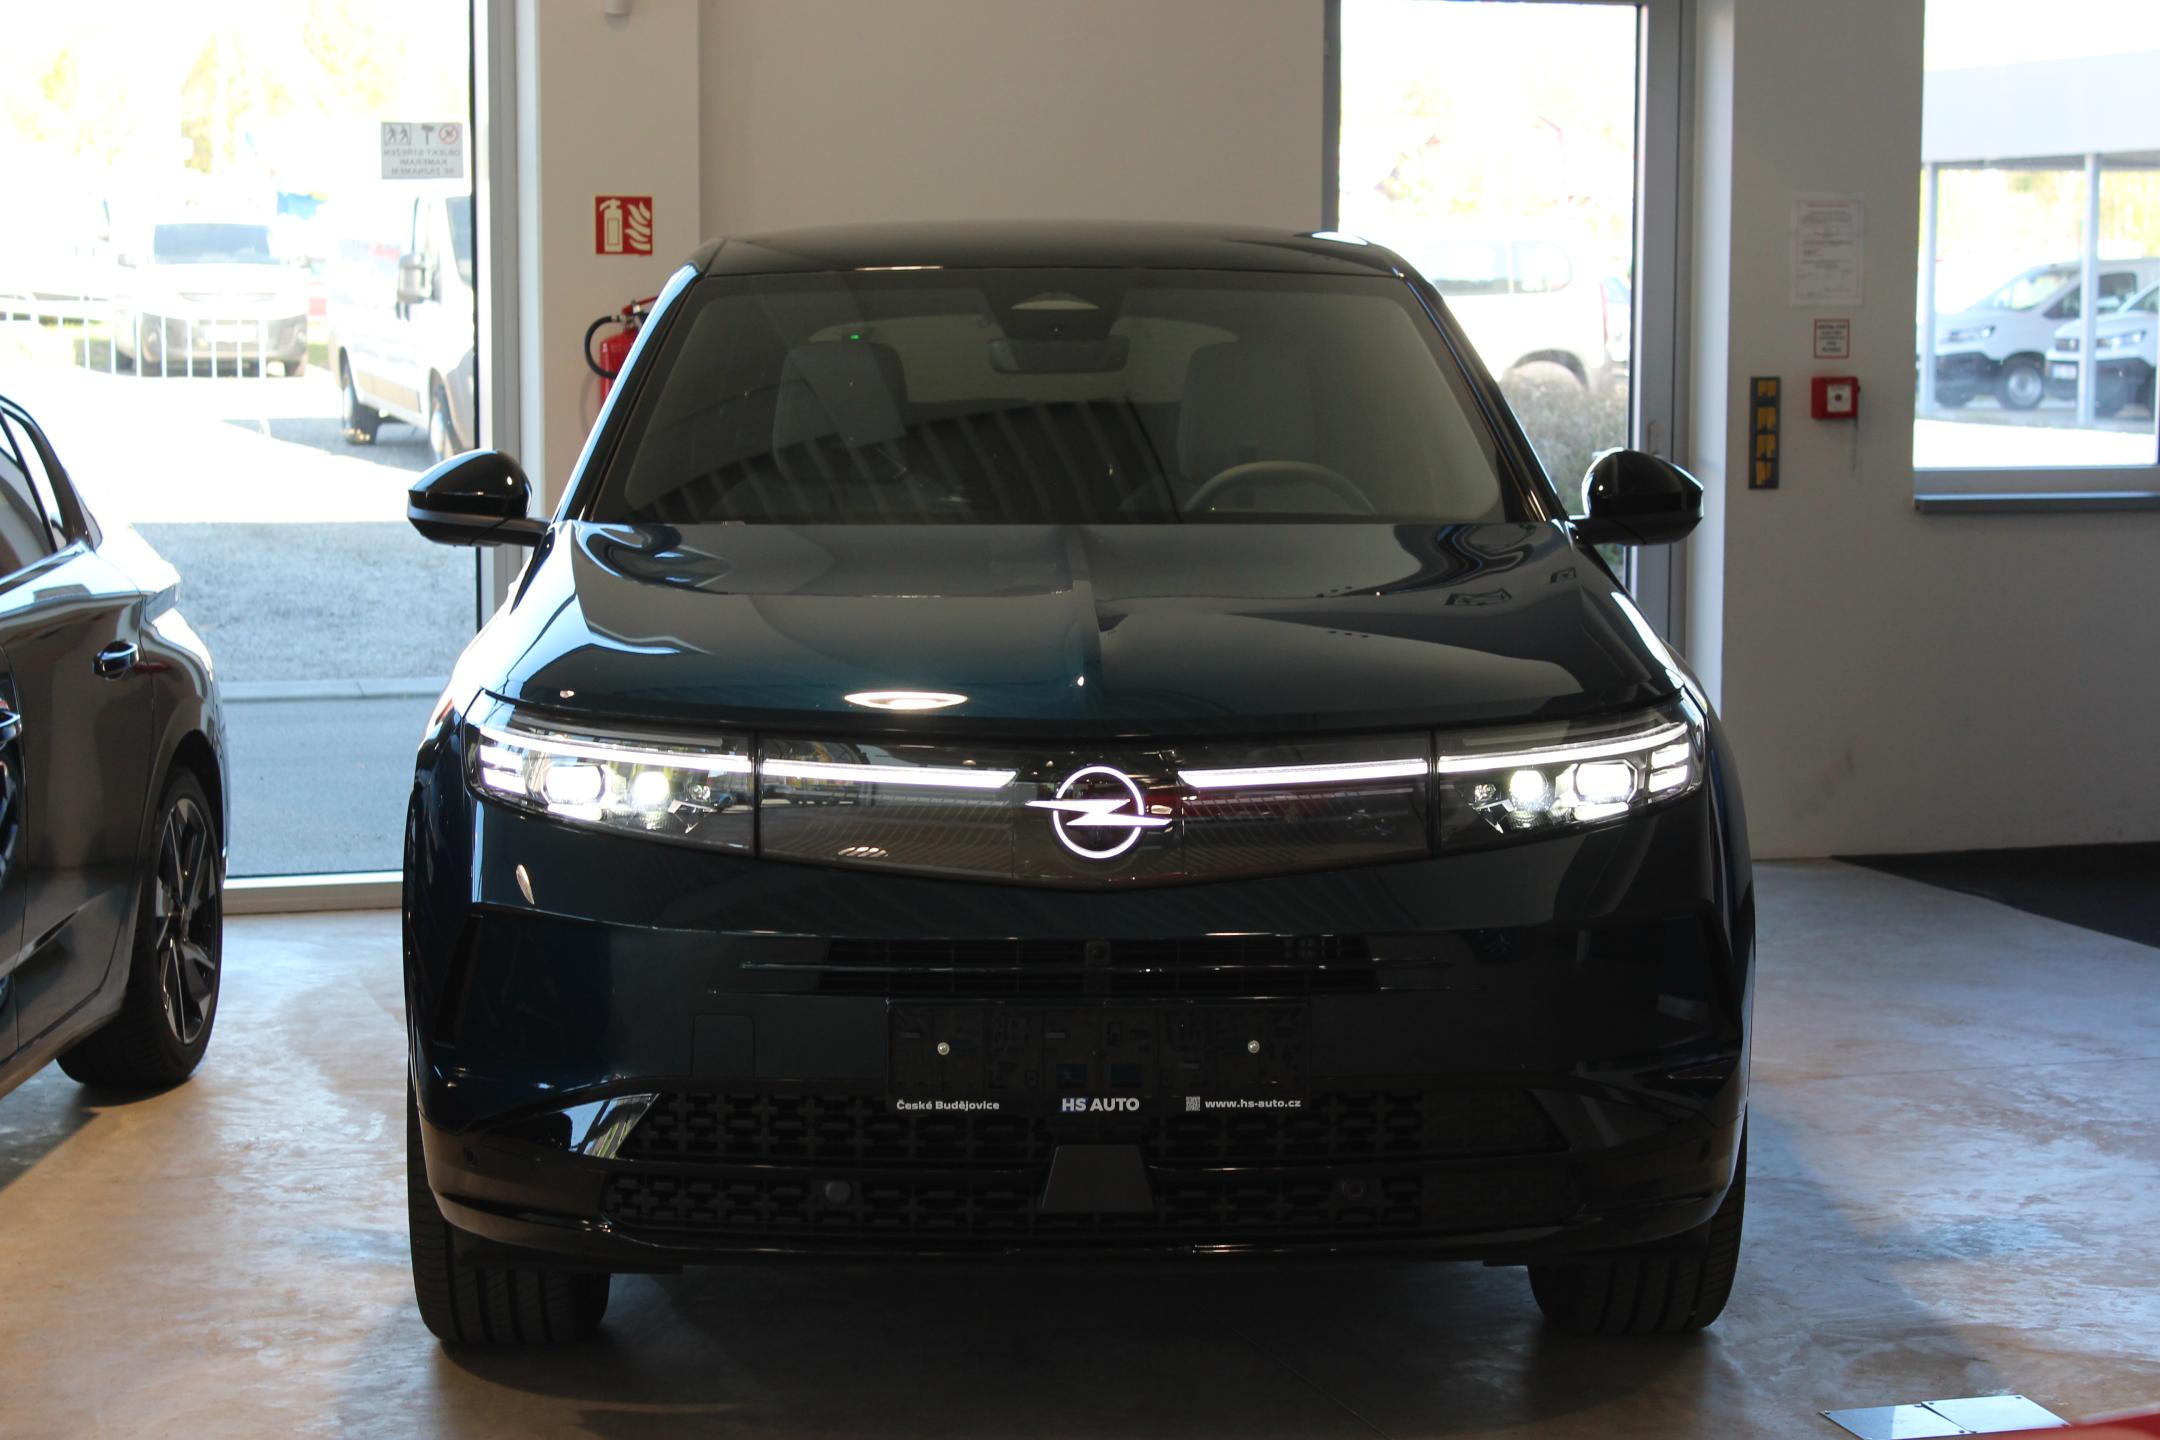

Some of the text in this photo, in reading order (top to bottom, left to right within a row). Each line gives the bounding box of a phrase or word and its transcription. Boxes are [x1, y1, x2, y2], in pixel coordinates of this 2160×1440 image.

[896, 1099, 1000, 1112] České Budějovice
[1061, 1097, 1140, 1112] HS AUTO
[1204, 1098, 1301, 1109] www.hs-auto.cz
